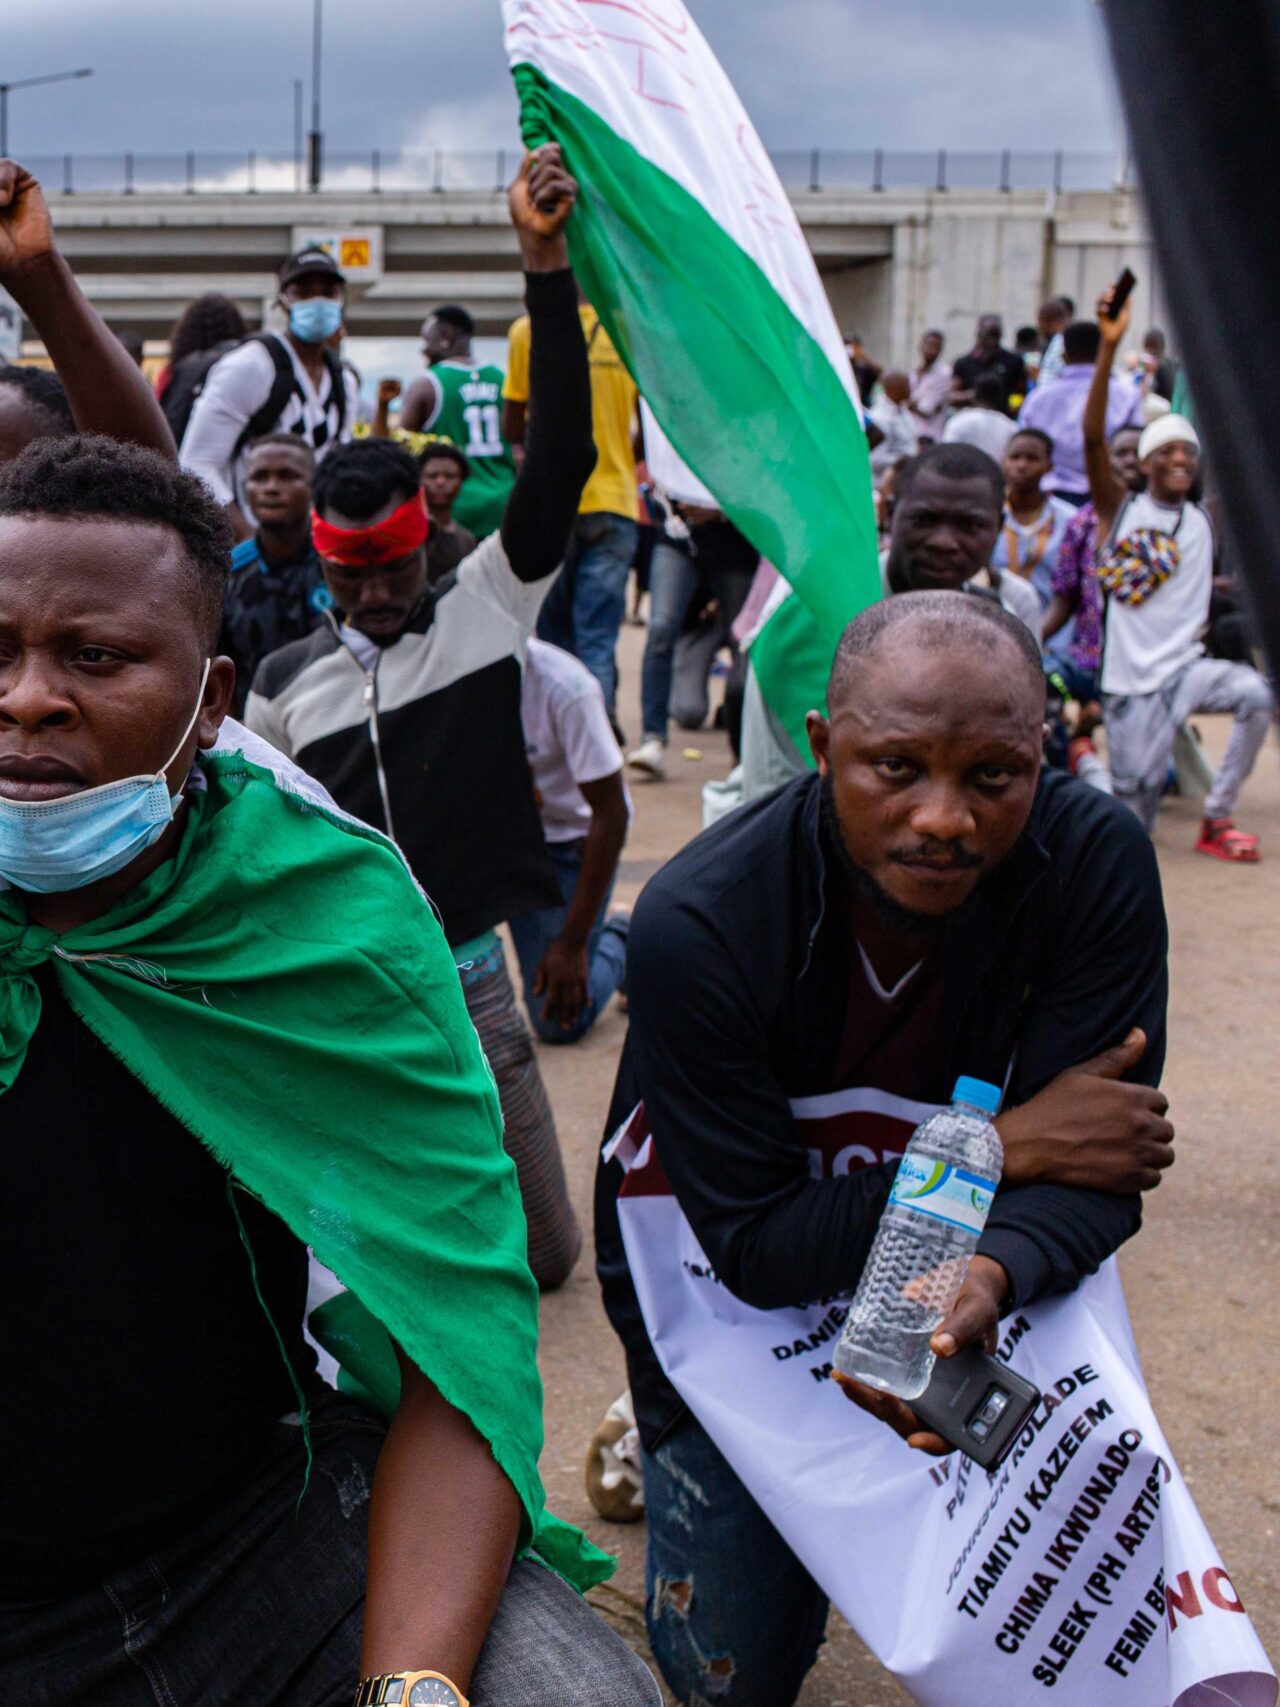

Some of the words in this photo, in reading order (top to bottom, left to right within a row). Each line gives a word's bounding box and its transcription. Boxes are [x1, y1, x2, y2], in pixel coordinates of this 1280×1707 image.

[463, 405, 504, 455] 11
[772, 1305, 852, 1361] DANIE
[957, 1507, 1031, 1619] TIAMIYU
[1024, 1398, 1114, 1511] KAZEEM
[994, 1571, 1060, 1655] CHIMA
[1043, 1428, 1143, 1572] IKWUNADO
[1032, 1600, 1098, 1688] SLEEK
[1083, 1552, 1128, 1606] (PH
[1104, 1609, 1158, 1678] FEMI
